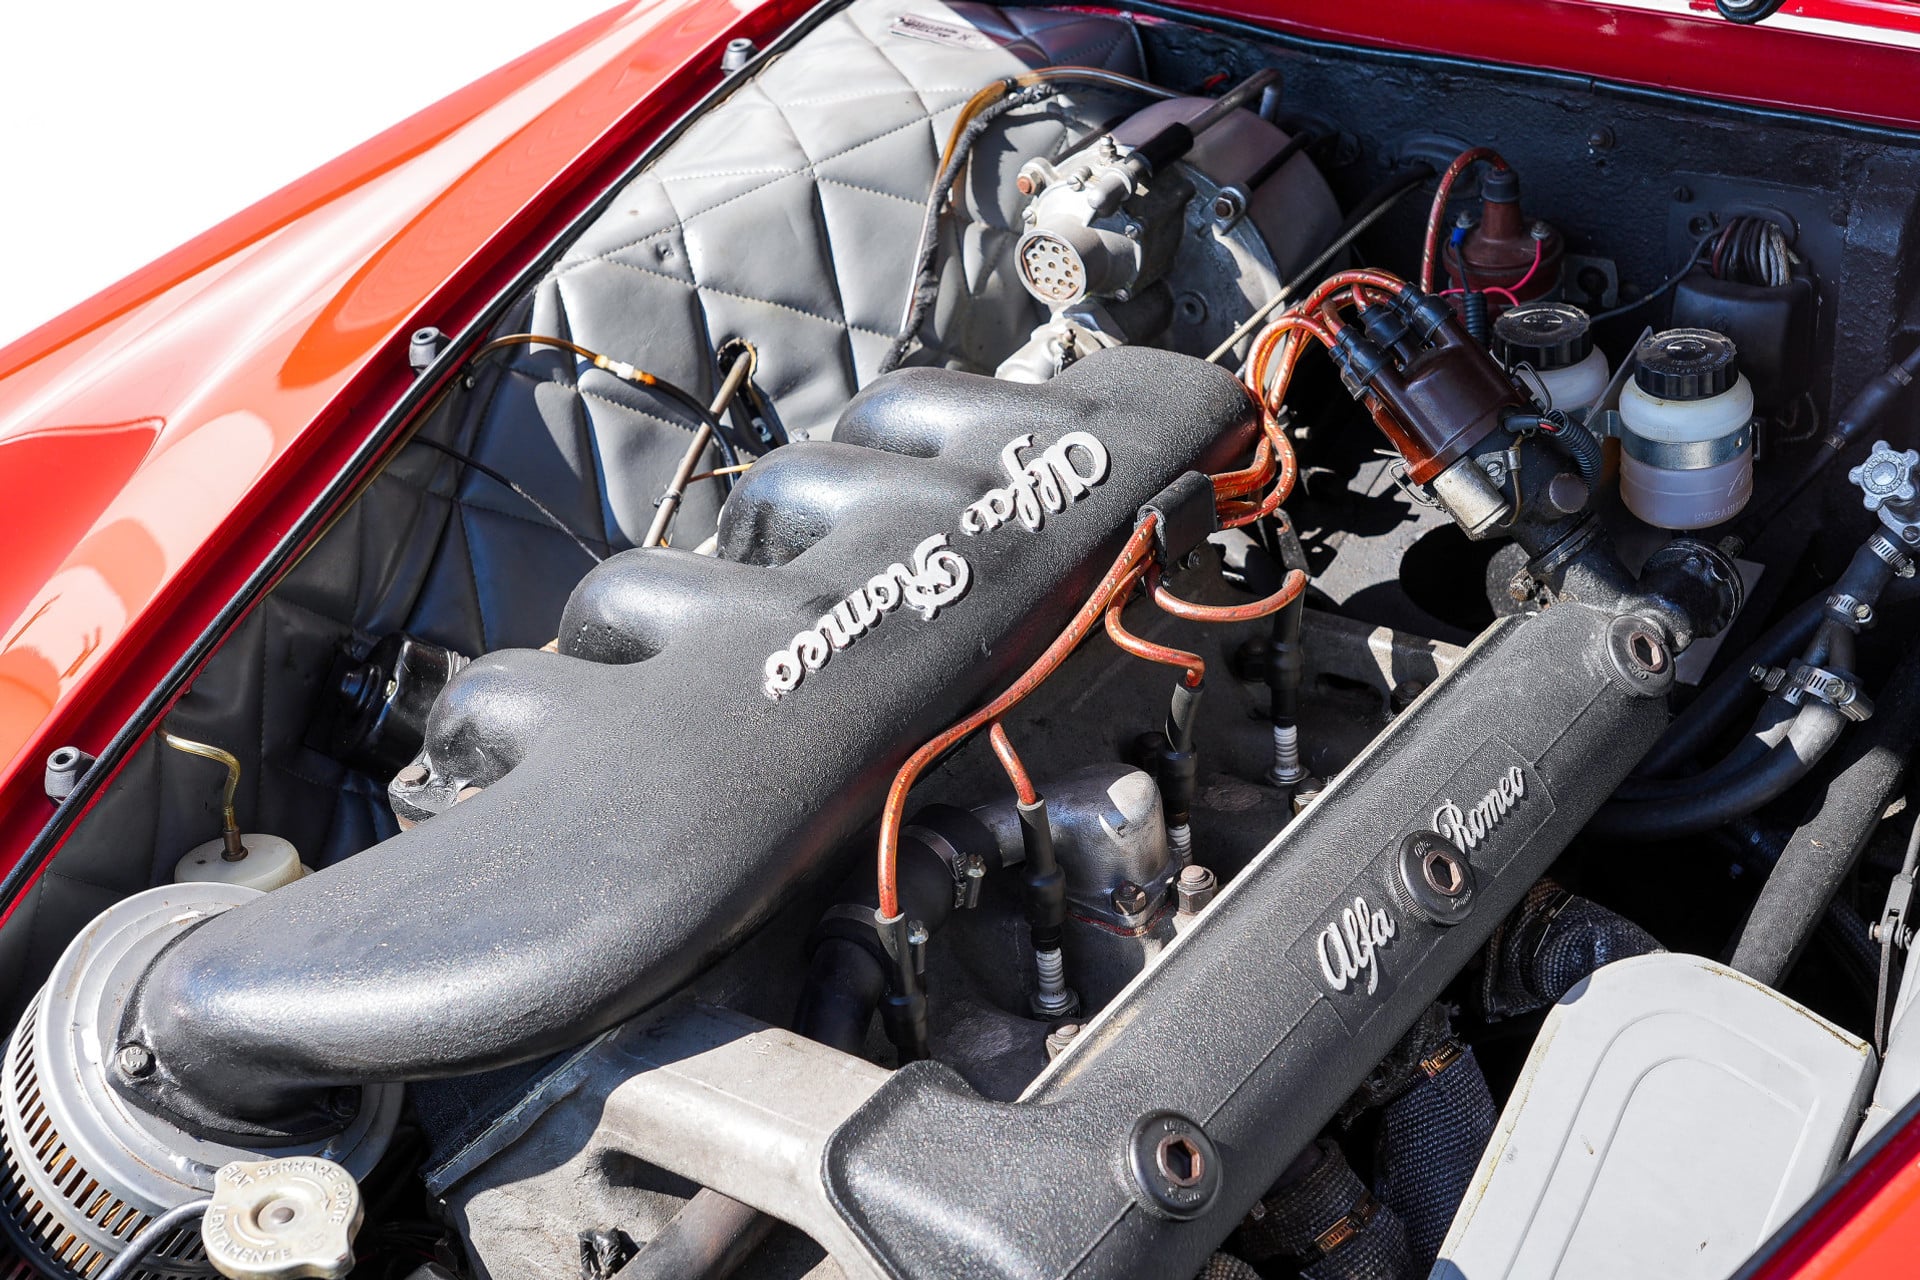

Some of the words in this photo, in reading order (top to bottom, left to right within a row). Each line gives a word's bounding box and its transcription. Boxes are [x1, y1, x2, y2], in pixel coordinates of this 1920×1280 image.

[960, 431, 1109, 534] Alfa
[765, 532, 973, 698] Romeo
[1318, 896, 1396, 996] Alfa
[1433, 766, 1525, 854] Romeo
[211, 1204, 293, 1262] LENTAMENTE
[257, 1161, 340, 1181] SERRARE
[330, 1180, 353, 1224] FORTE
